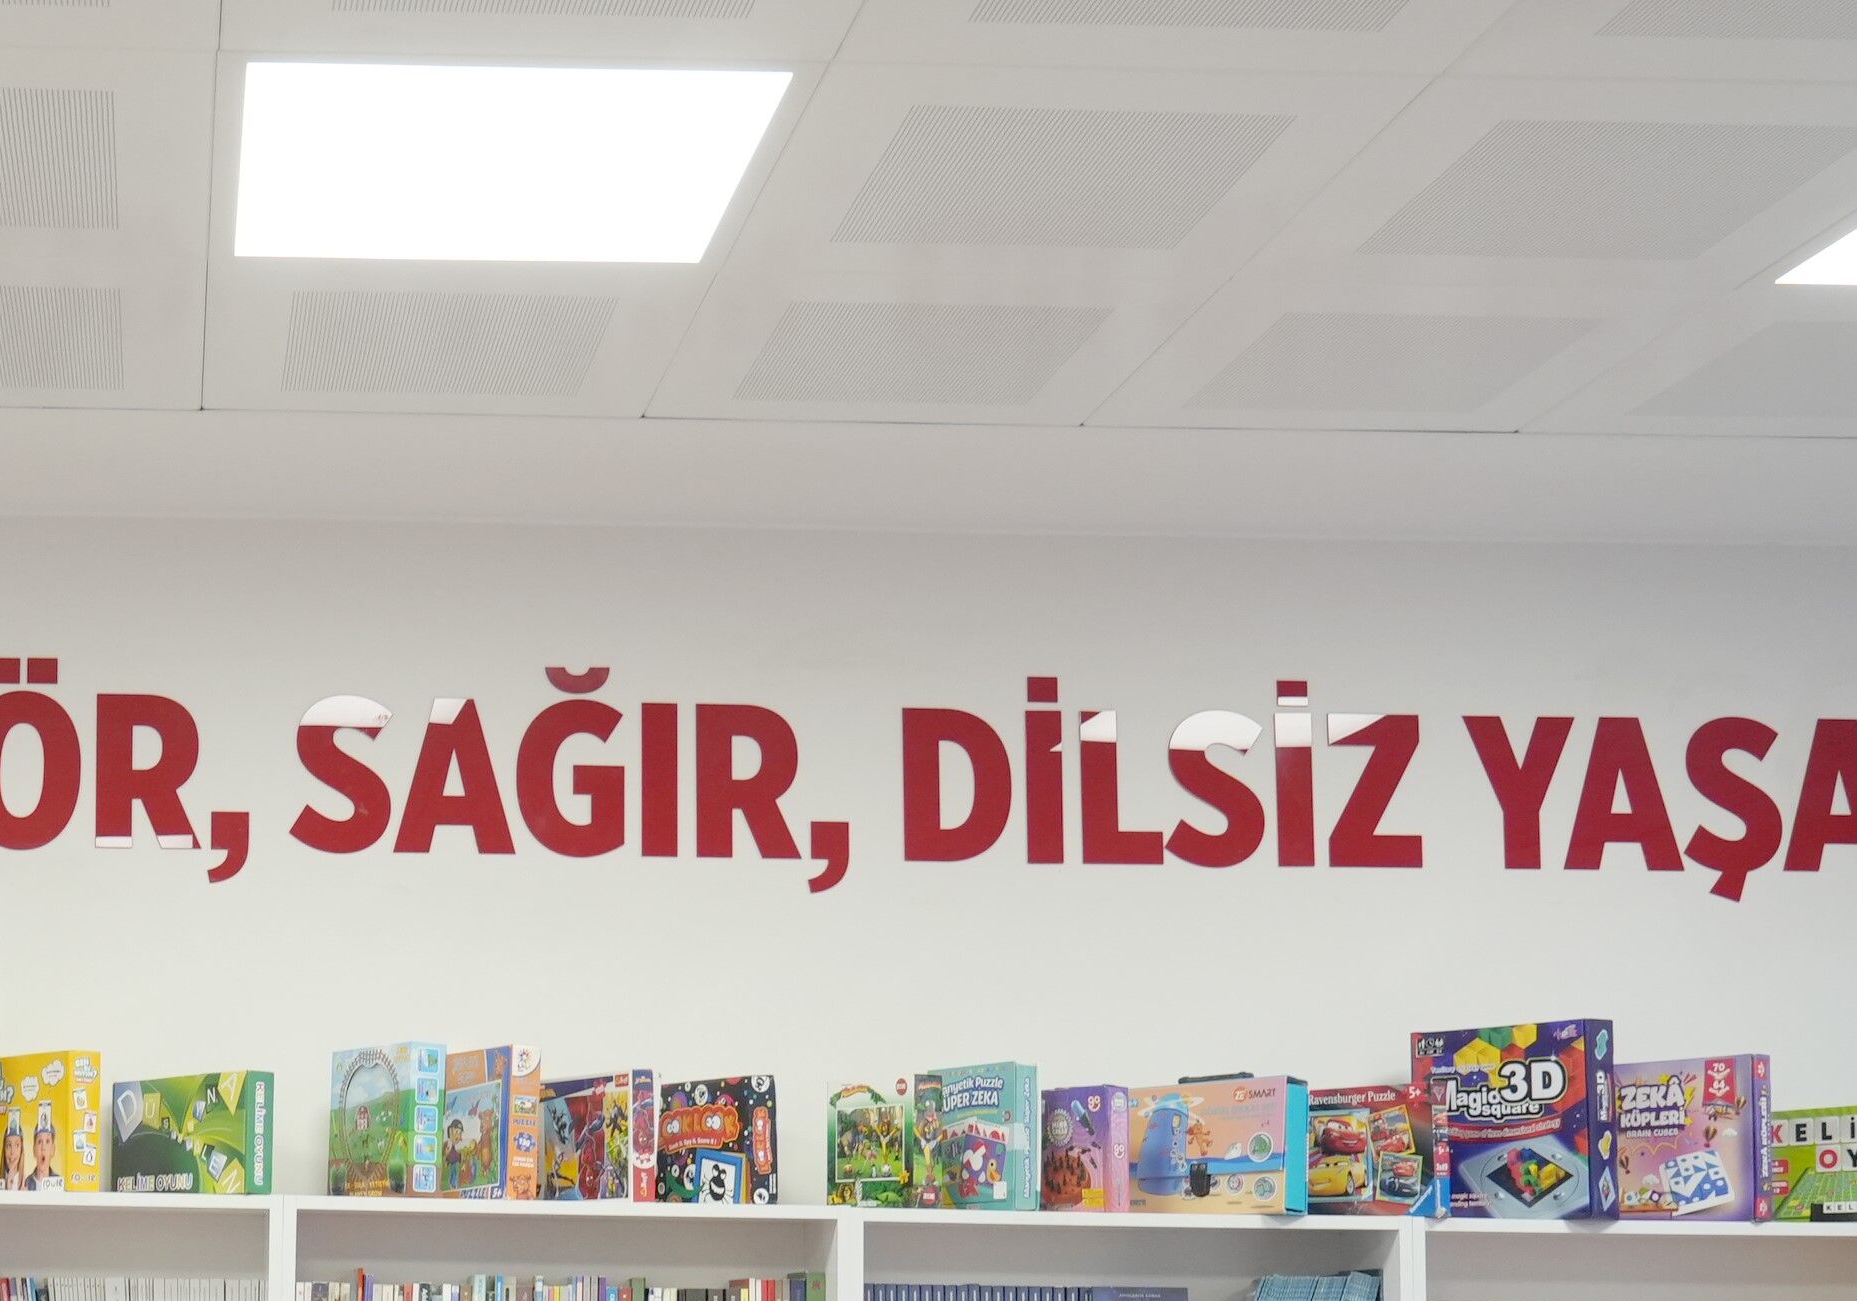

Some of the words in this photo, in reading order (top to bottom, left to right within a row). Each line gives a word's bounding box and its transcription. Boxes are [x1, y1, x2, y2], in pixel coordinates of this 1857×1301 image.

[290, 666, 850, 893] SAĞIR,
[902, 676, 1424, 868] DİLSİZ
[1713, 1063, 1725, 1071] 70
[942, 1080, 974, 1096] anyetik
[976, 1076, 1004, 1090] Puzzle
[1498, 1060, 1565, 1101] 3D
[972, 1091, 999, 1106] ZEKA
[1309, 1094, 1365, 1105] Ravensburger
[1368, 1092, 1396, 1102] Puzzle
[1408, 1087, 1421, 1099] 5+
[1621, 1075, 1685, 1110] ZEKÂ
[256, 1081, 265, 1131] KELİME
[1620, 1108, 1685, 1128] KÜPLERİ
[254, 1136, 264, 1186] OYUNU
[117, 1174, 154, 1191] KELİME
[156, 1172, 192, 1190] OYUNU
